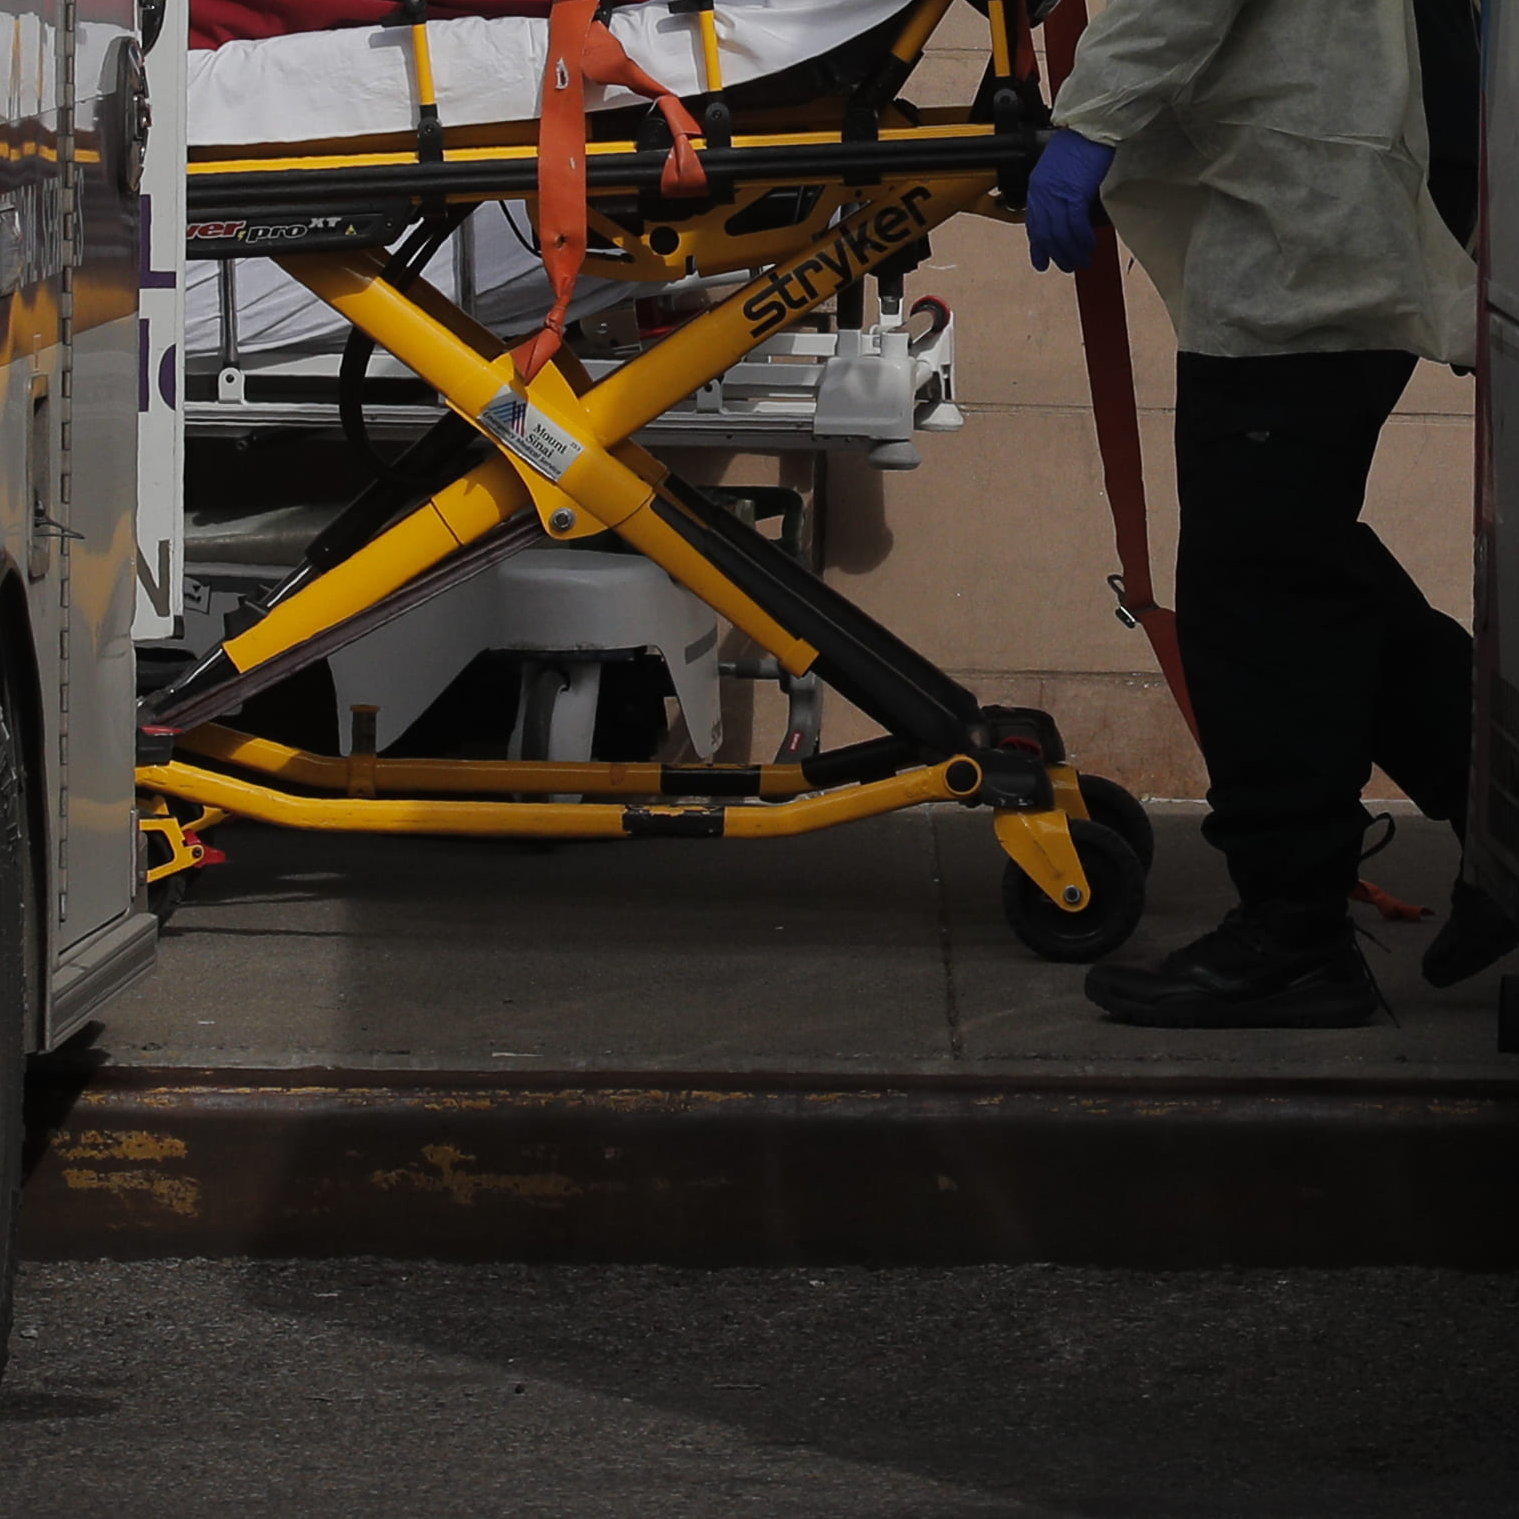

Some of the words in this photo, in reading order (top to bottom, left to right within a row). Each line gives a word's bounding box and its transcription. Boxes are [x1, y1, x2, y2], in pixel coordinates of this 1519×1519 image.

[743, 185, 932, 339] stryker
[525, 433, 556, 458] Sinai
[533, 423, 568, 455] Mount
